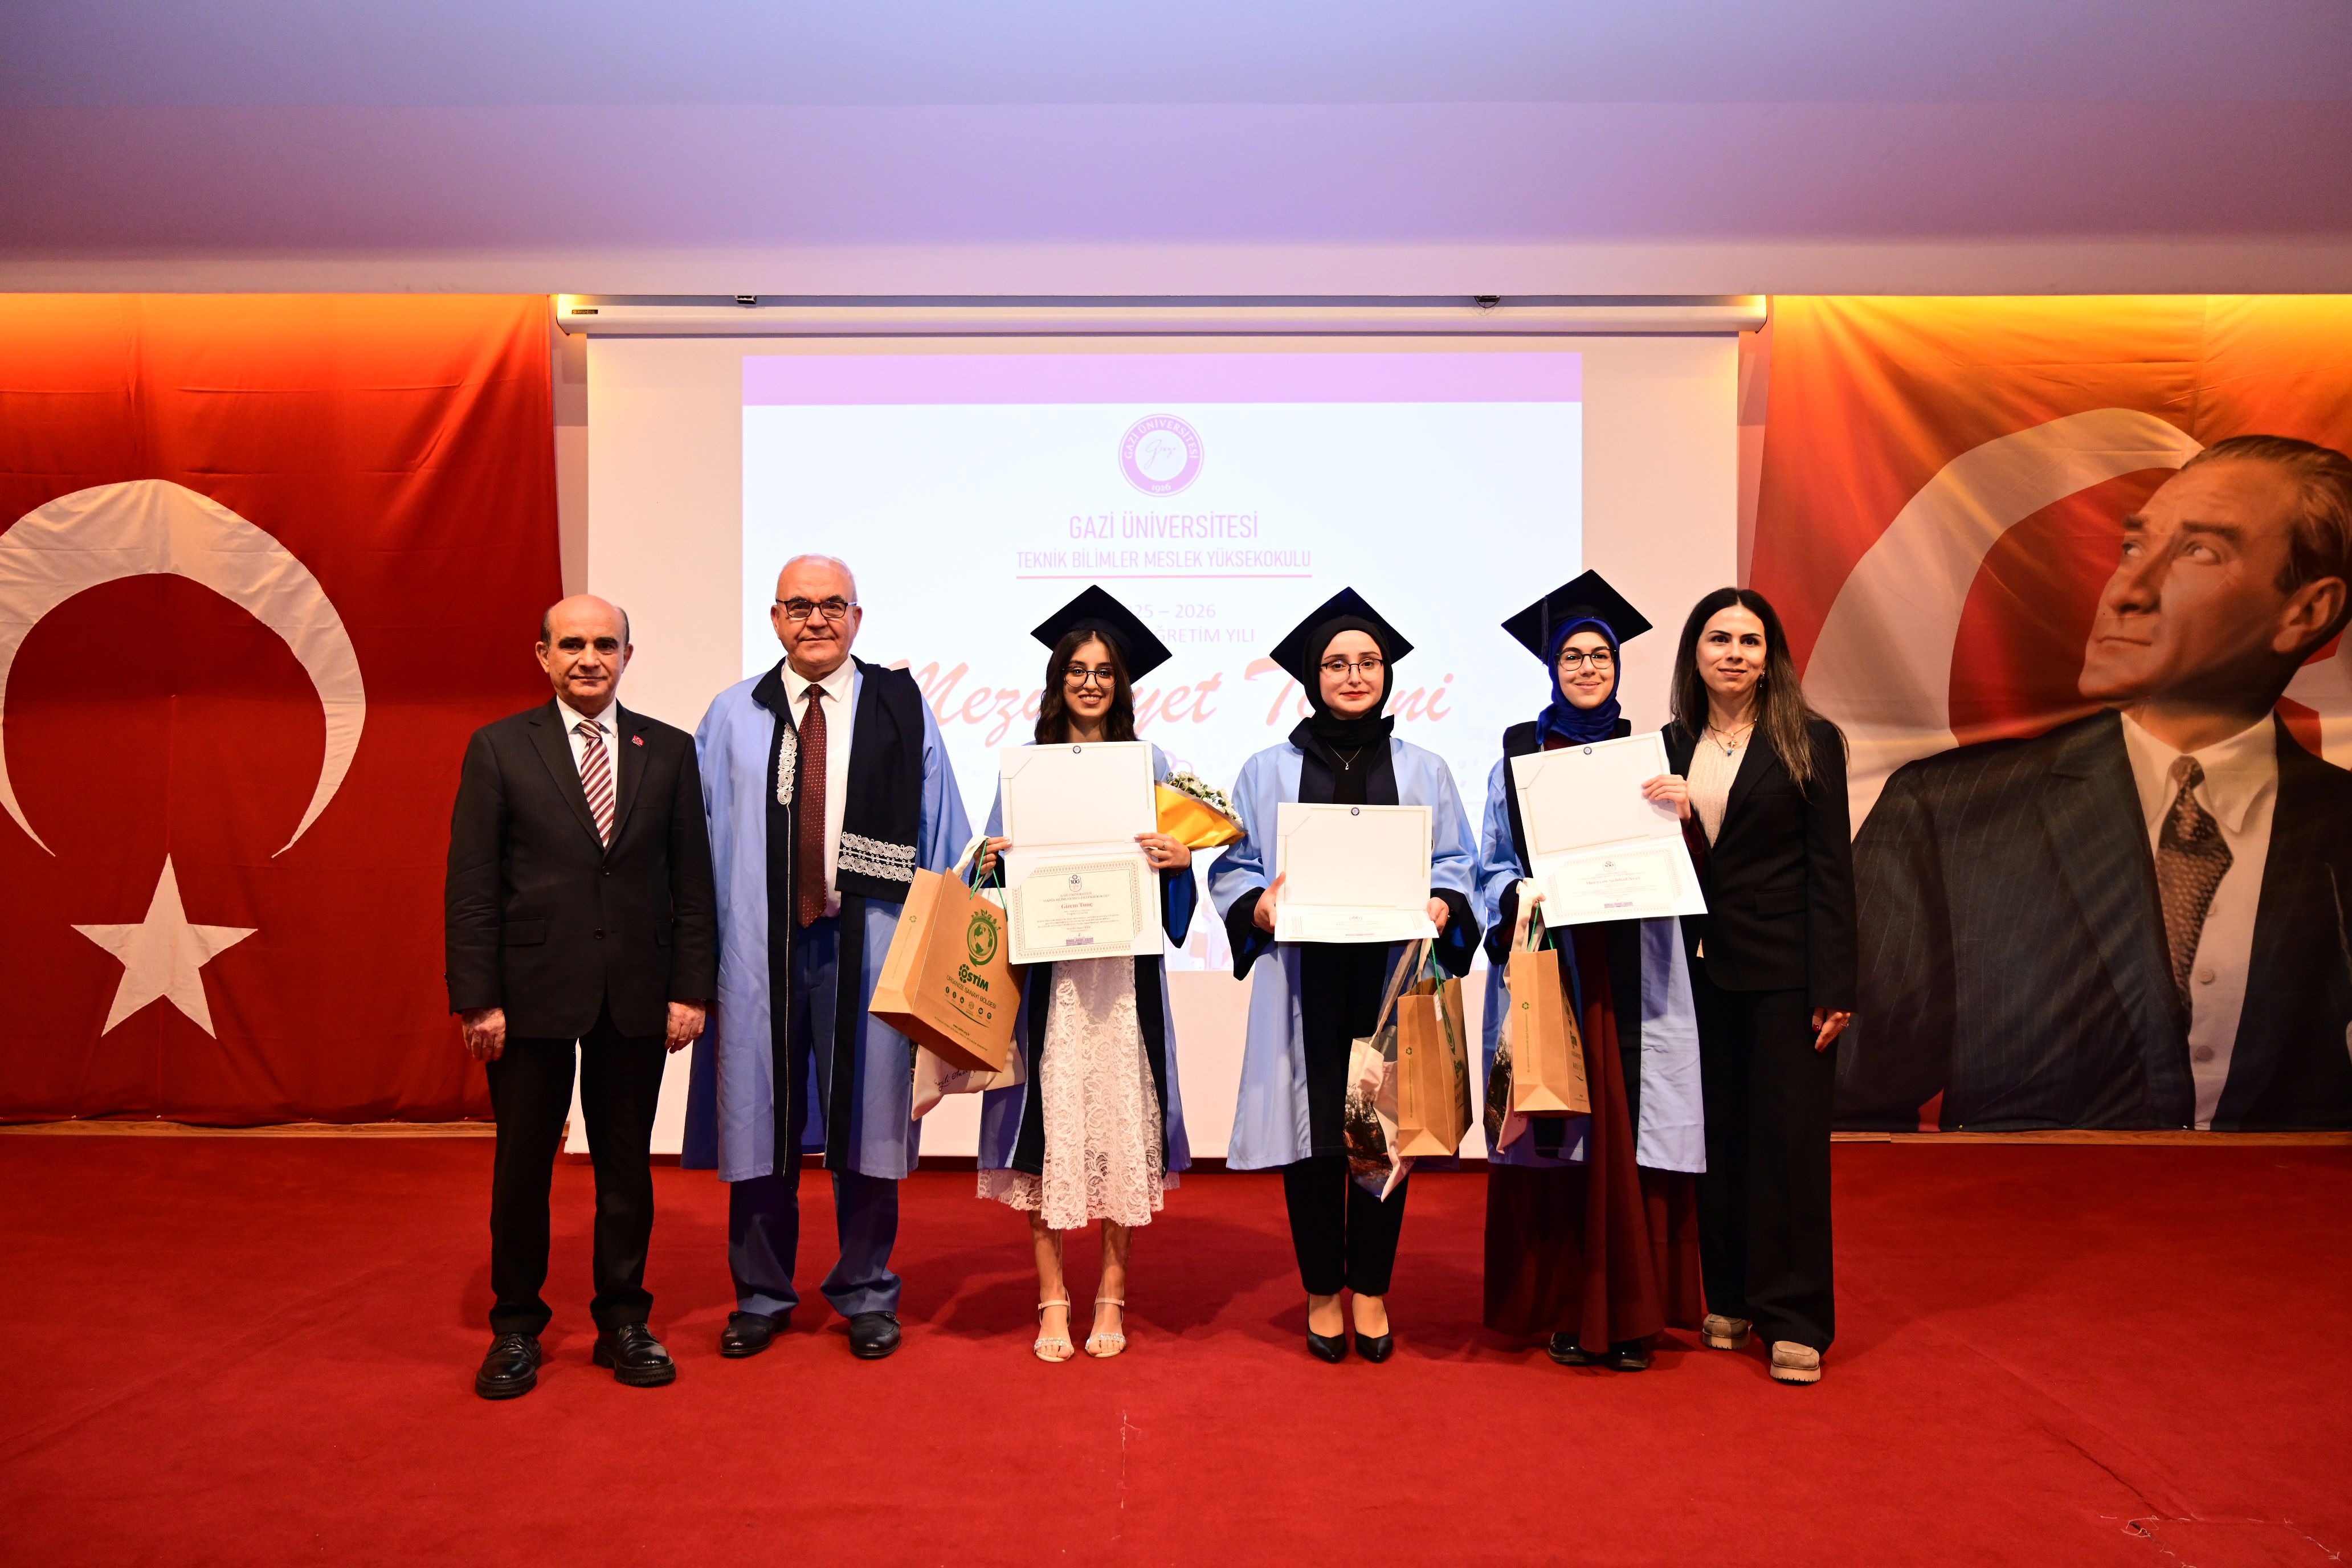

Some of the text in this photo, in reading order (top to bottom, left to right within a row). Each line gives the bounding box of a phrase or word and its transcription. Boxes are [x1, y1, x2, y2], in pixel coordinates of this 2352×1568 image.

[1152, 483, 1171, 493] 1926
[1069, 510, 1258, 539] GAZİ ÜNİVERSİTESİ
[1016, 548, 1311, 569] TEKNİK BİLİMLER MESLEK YÜKSEKOKULU
[1125, 604, 1154, 619] 25
[1175, 604, 1216, 618] 2026
[1154, 624, 1254, 643] ĞRETİM YILI
